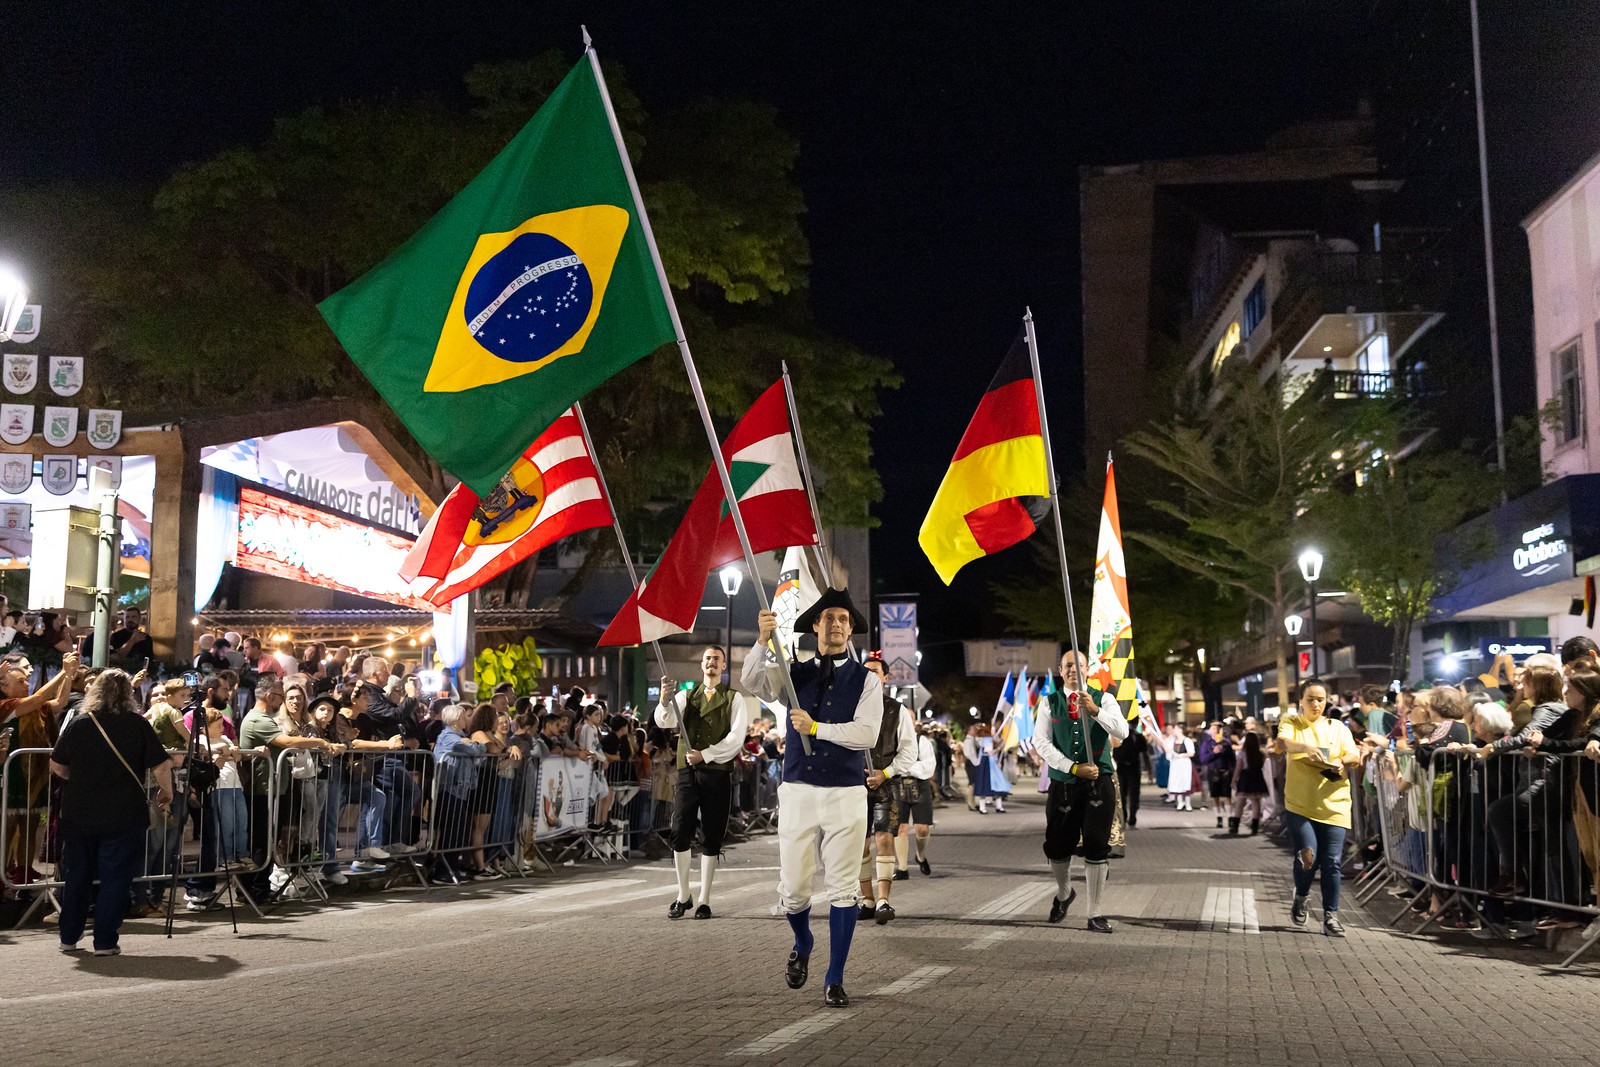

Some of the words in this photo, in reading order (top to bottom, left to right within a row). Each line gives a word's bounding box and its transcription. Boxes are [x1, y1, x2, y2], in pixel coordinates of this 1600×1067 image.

[470, 300, 501, 332] ORDEM
[510, 256, 578, 290] PROGRESSO
[284, 469, 363, 517] CAMAROTE
